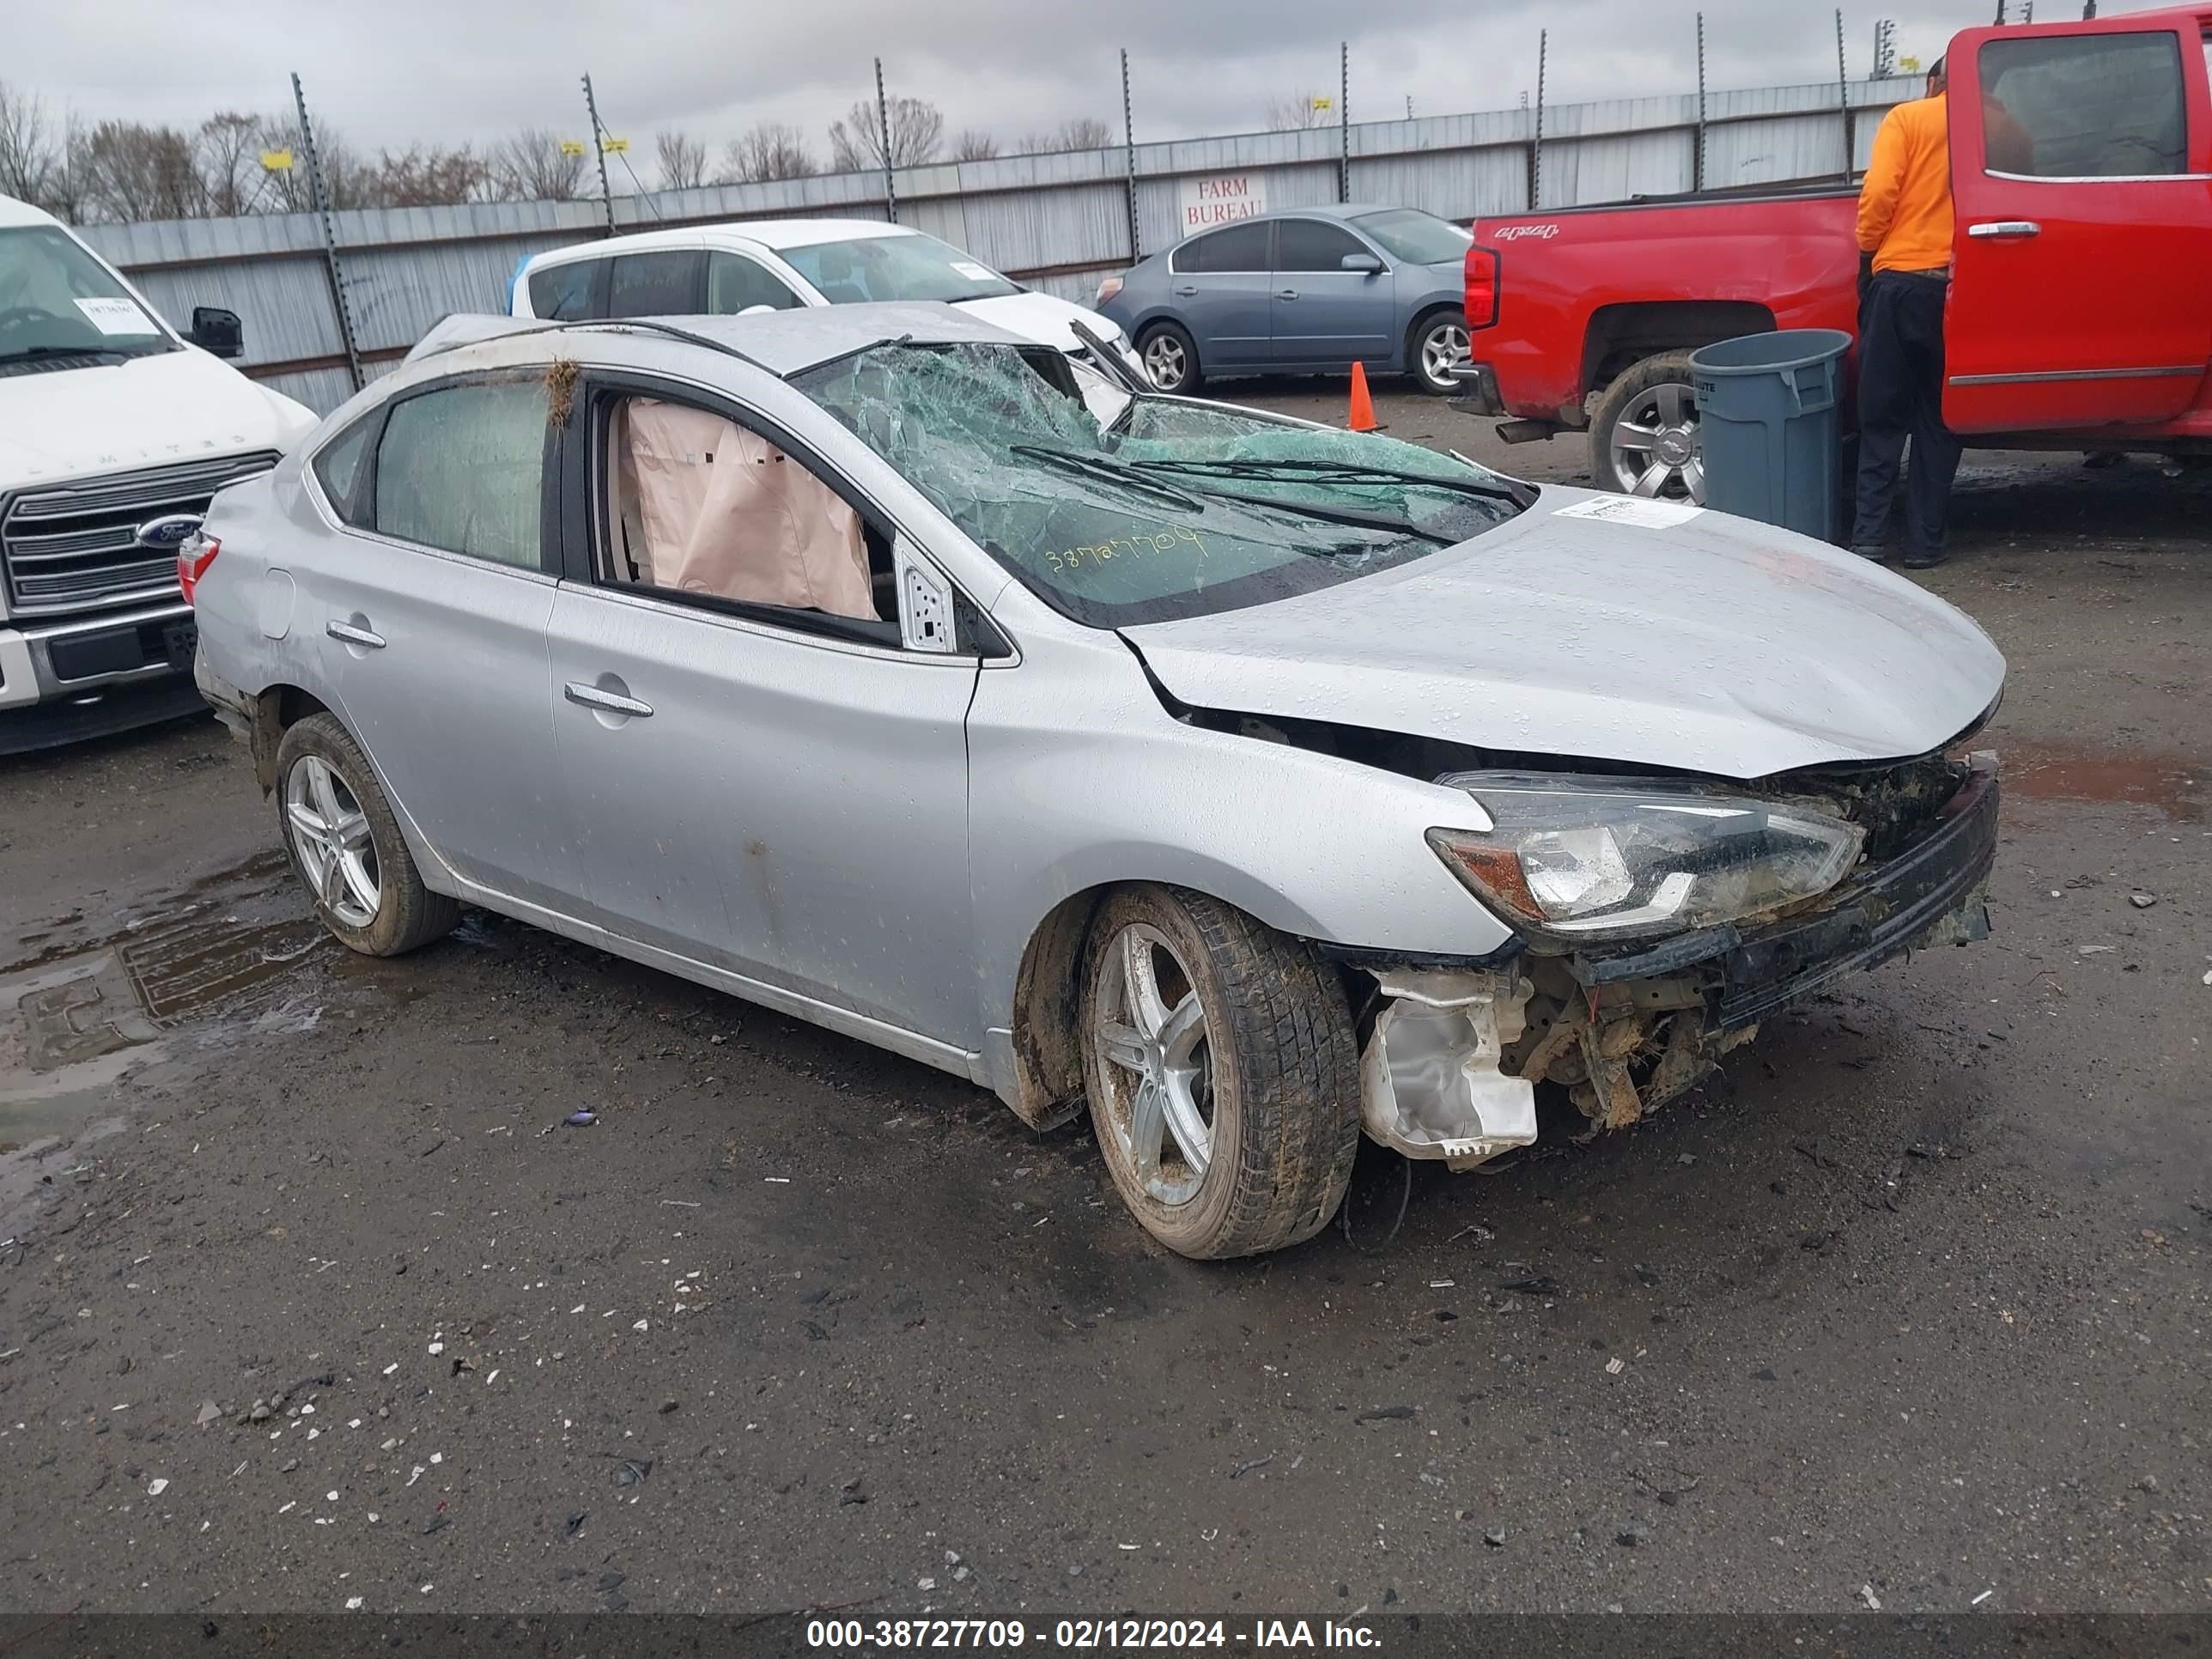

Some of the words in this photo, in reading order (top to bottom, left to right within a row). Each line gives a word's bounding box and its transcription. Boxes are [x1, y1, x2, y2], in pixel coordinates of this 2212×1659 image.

[1199, 178, 1248, 200] FARM
[1188, 199, 1261, 225] BUREAU
[160, 522, 193, 541] Ford
